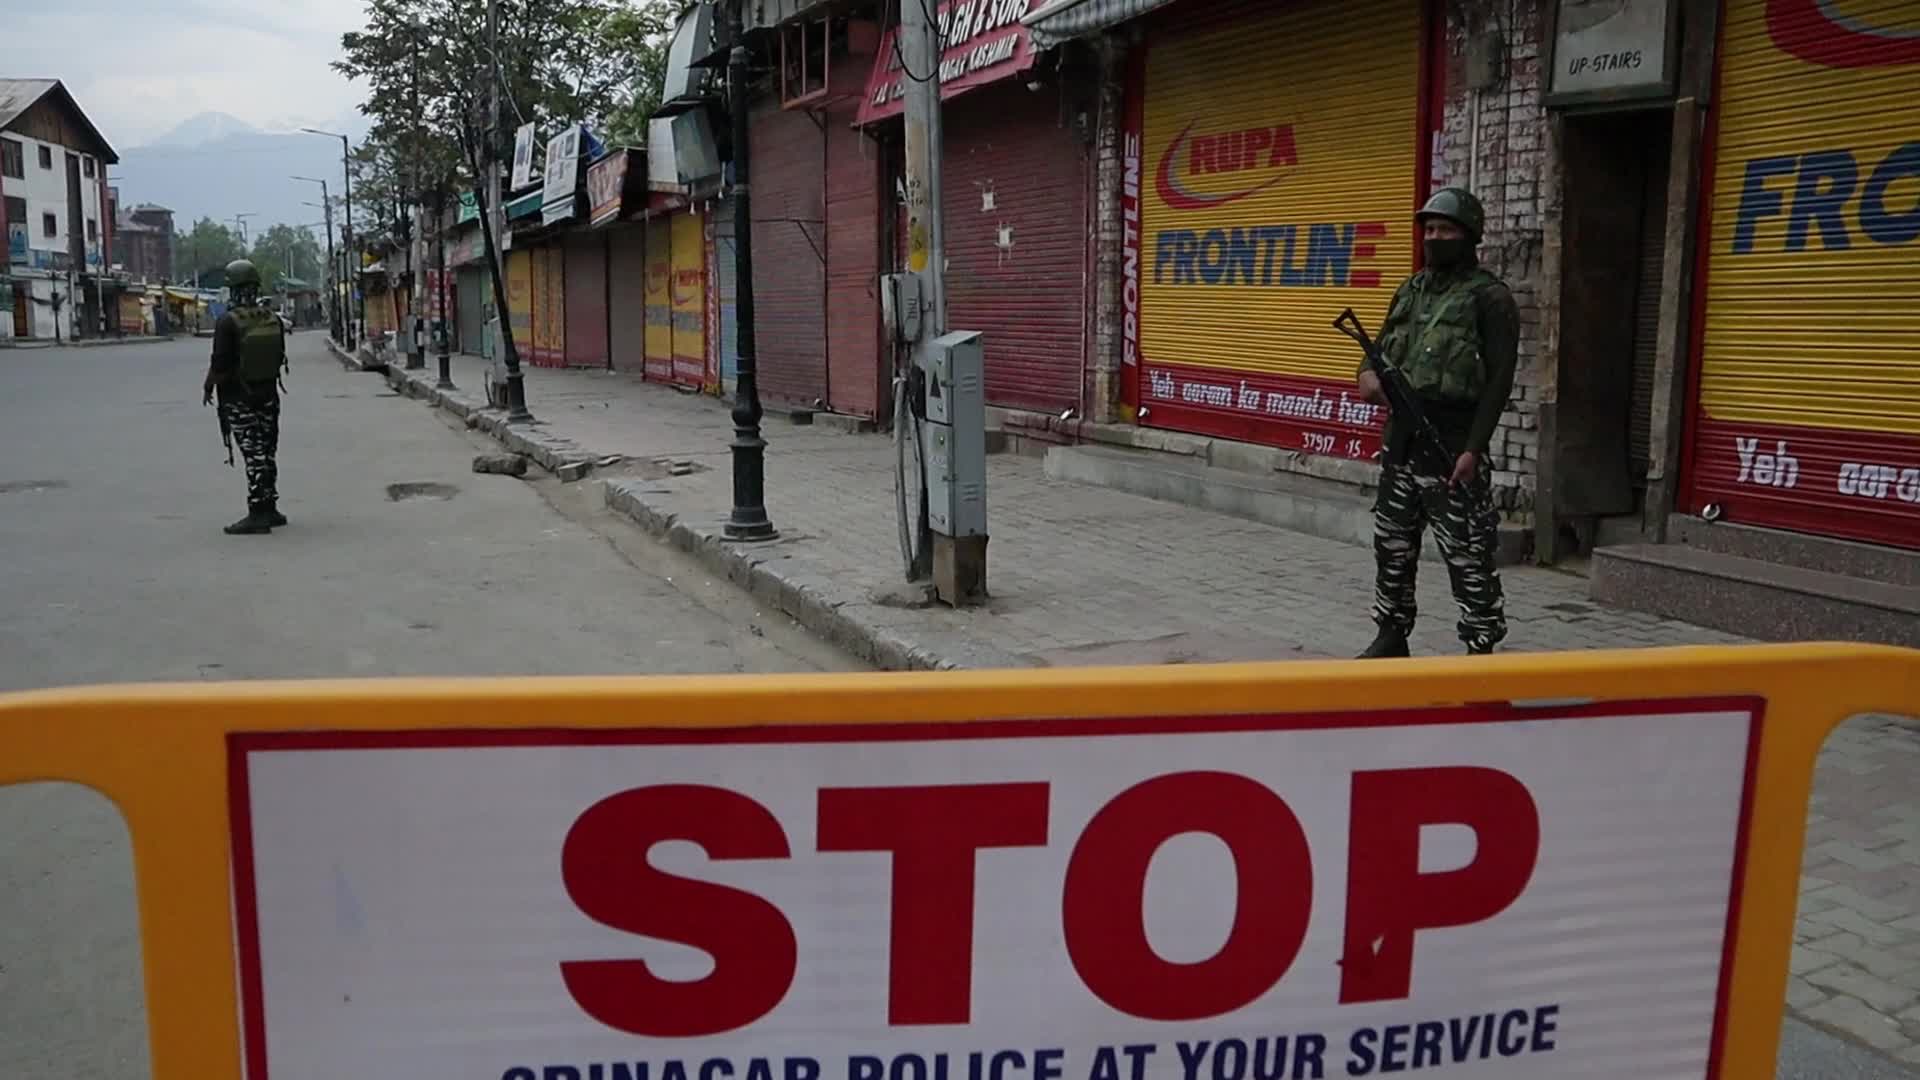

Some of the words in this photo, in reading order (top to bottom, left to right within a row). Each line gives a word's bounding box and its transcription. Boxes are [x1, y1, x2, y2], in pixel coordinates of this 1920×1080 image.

[969, 33, 1018, 71] KASHMIR
[1569, 50, 1642, 75] UP-STAIRS
[1189, 123, 1298, 175] RUPA
[1122, 132, 1139, 367] FRONTLINE
[1153, 221, 1388, 288] FRONTLINE
[1735, 437, 1799, 488] Yeh
[1837, 463, 1920, 503] aara
[560, 765, 1539, 1038] STOP
[1089, 1044, 1155, 1080] AT
[1176, 1033, 1327, 1080] YOUR
[1346, 1005, 1559, 1077] SERVICE
